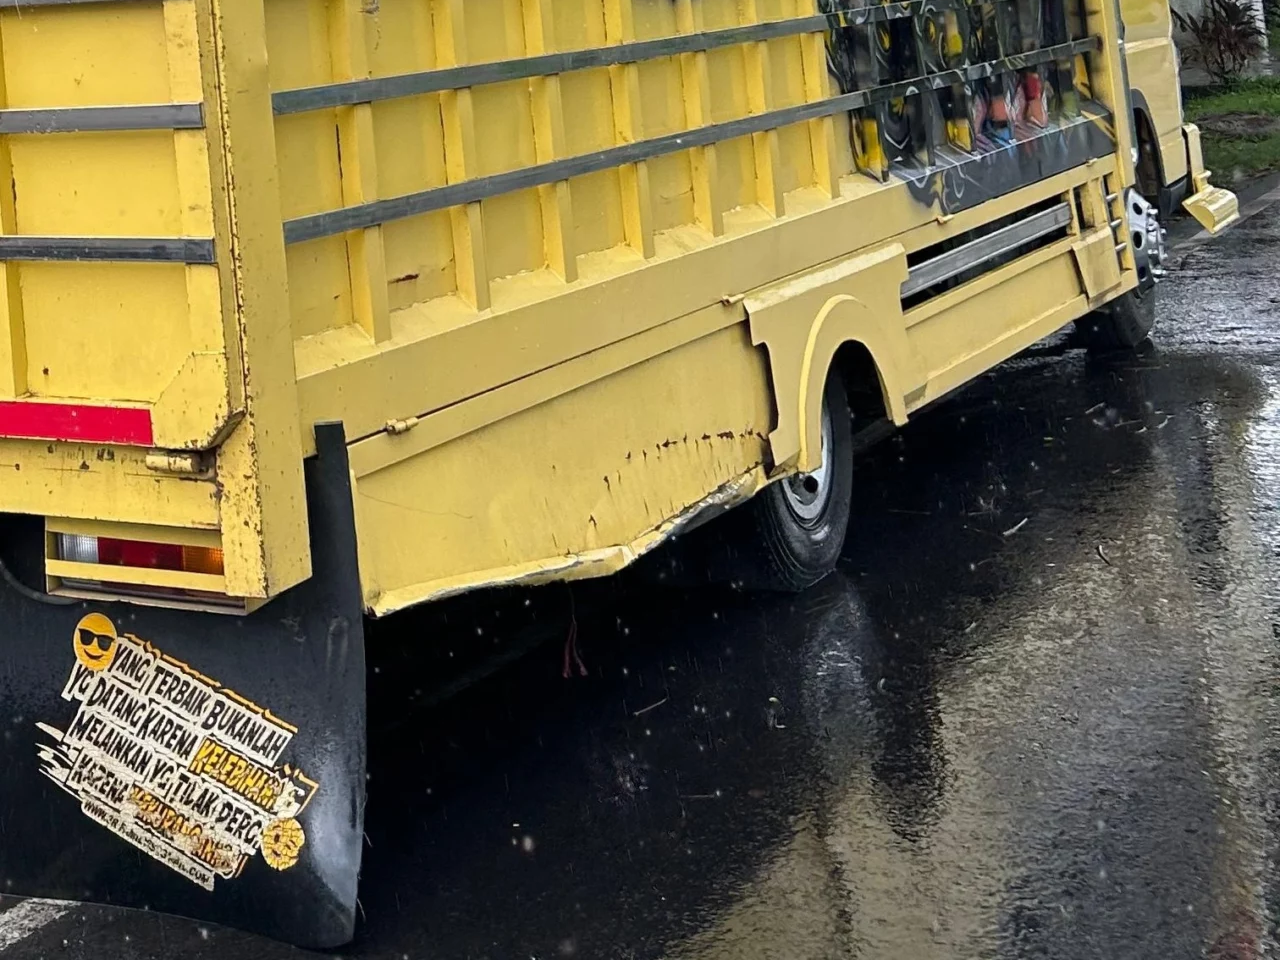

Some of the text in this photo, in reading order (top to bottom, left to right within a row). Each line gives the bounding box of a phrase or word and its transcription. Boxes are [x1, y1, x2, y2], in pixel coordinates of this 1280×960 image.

[67, 664, 95, 695] YG
[86, 677, 147, 728] DATANG
[135, 708, 198, 761] KARENA
[69, 710, 152, 775] MELAINKAN
[107, 643, 288, 761] YANG TERBAIK BUKANLAH
